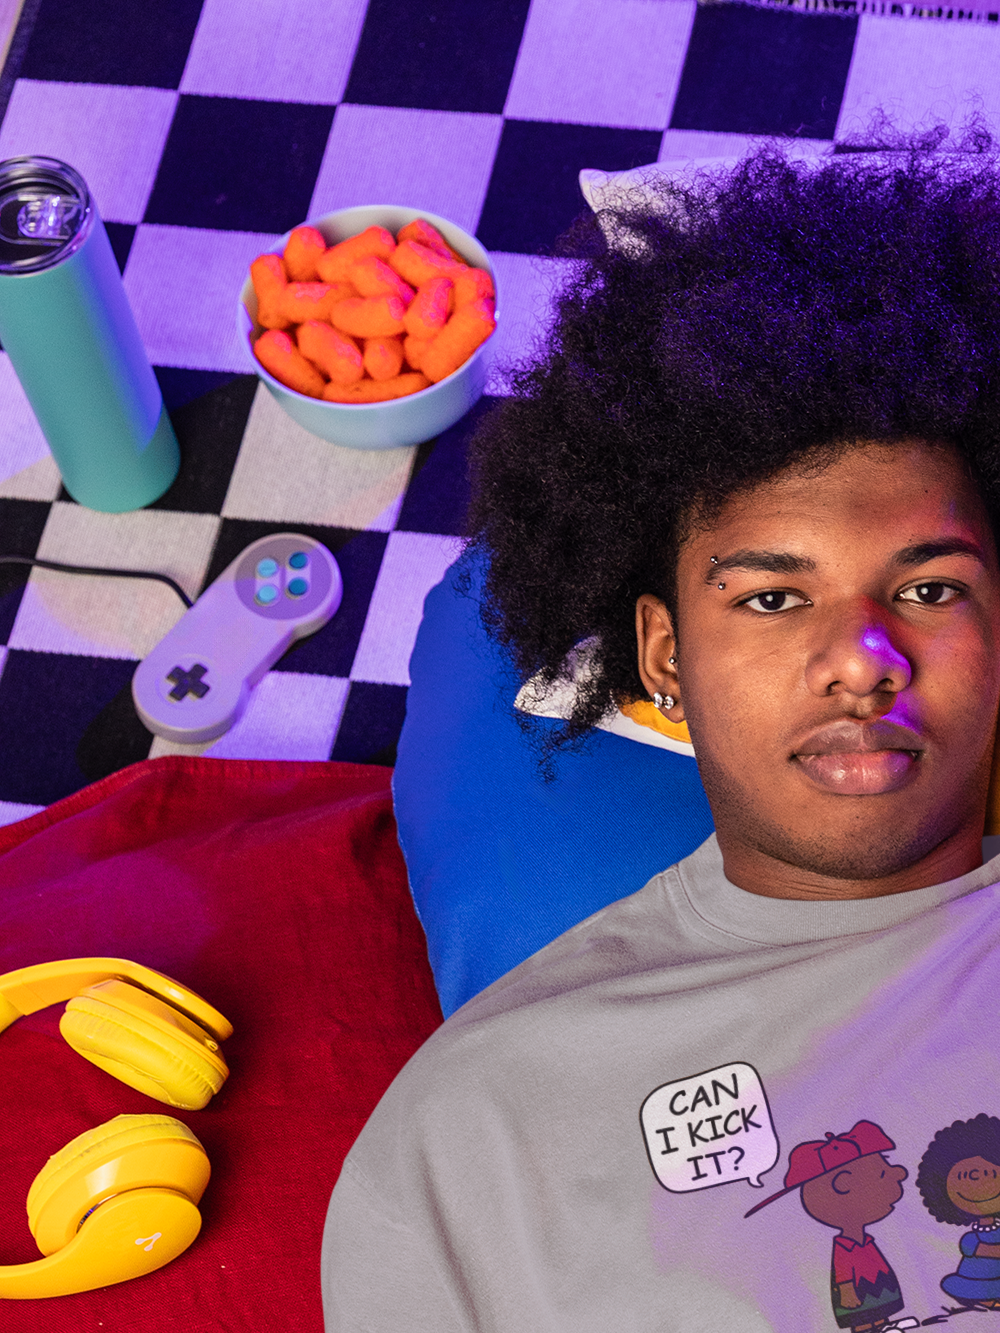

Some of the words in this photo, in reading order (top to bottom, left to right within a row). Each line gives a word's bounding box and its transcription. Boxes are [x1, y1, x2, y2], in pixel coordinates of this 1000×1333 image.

[669, 1073, 738, 1116] CAN
[655, 1126, 679, 1155] I
[687, 1104, 762, 1147] KICK
[687, 1146, 745, 1181] IT?
